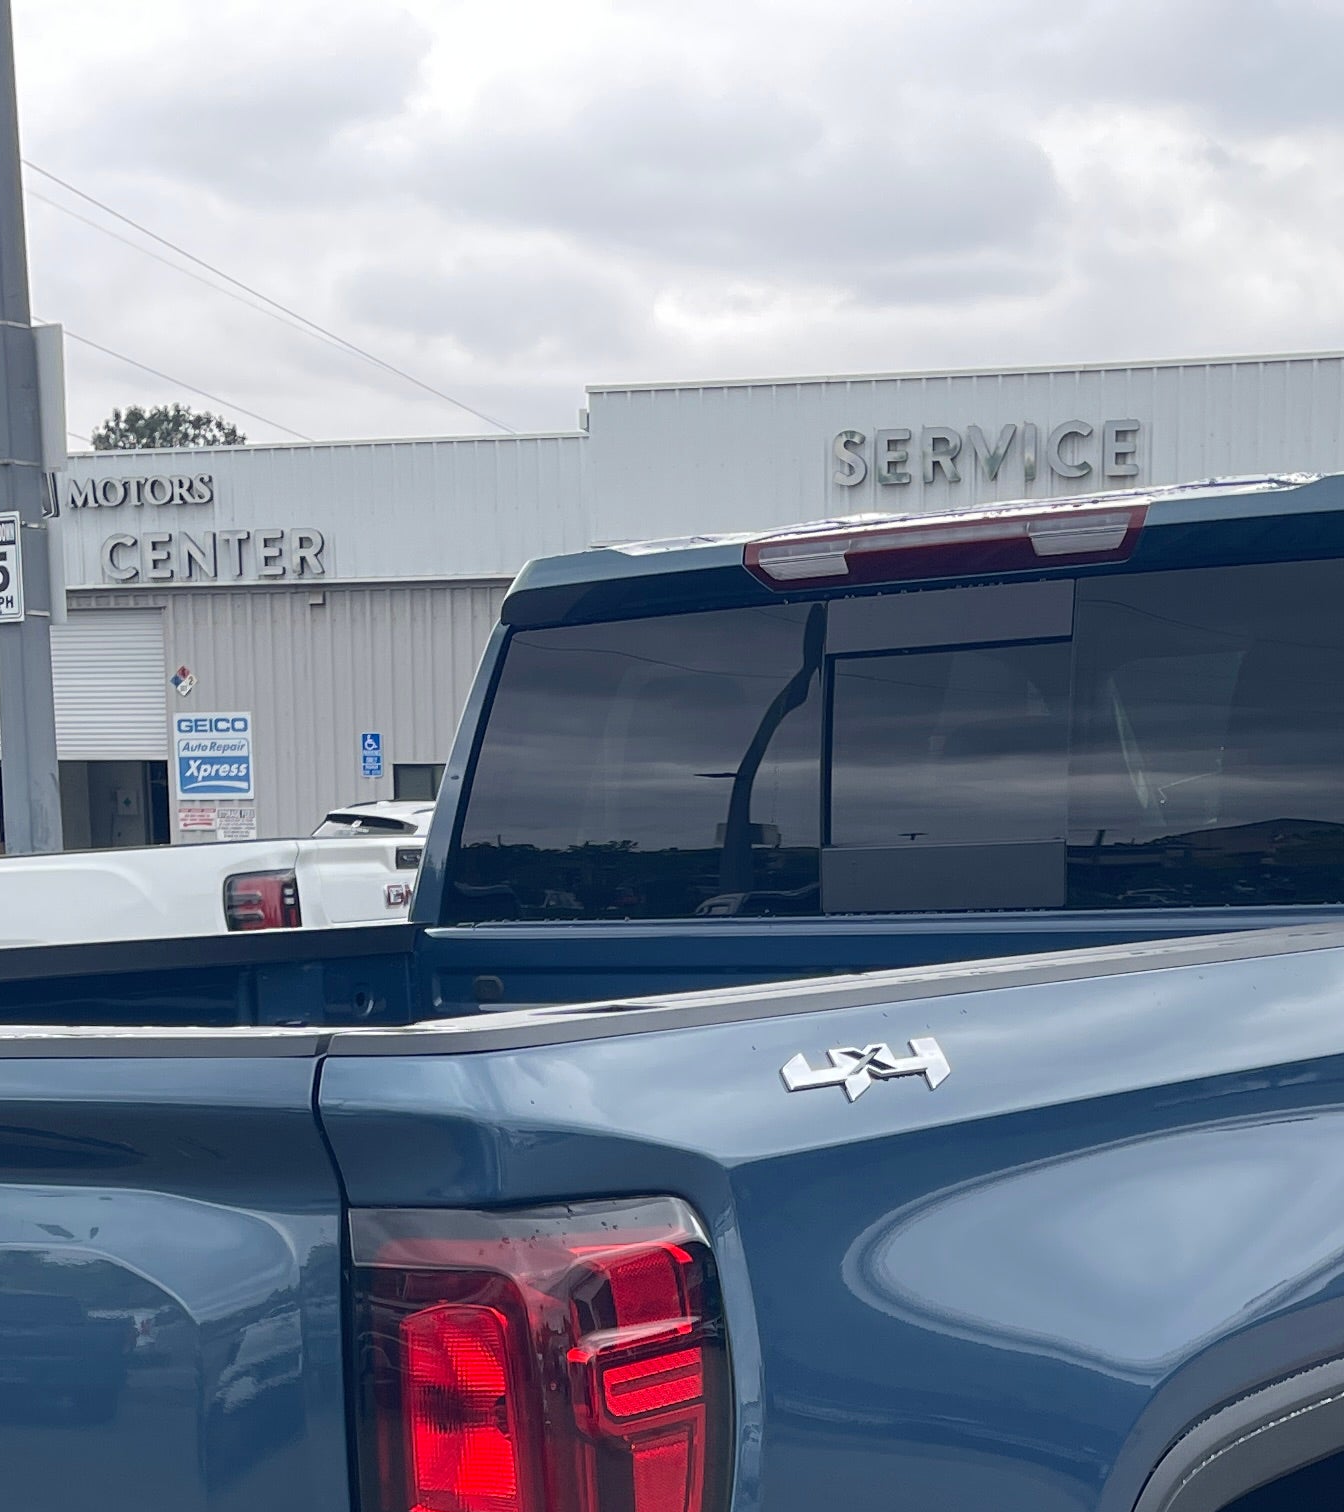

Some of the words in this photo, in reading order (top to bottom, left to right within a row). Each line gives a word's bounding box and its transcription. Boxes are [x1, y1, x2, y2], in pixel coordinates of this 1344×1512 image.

[832, 418, 1142, 487] SERVICE
[67, 472, 214, 509] MOTORS
[102, 526, 326, 581] CENTER
[177, 717, 248, 734] GEICO
[182, 741, 208, 753] Auto
[209, 740, 246, 754] Repair
[184, 759, 248, 782] Xpress
